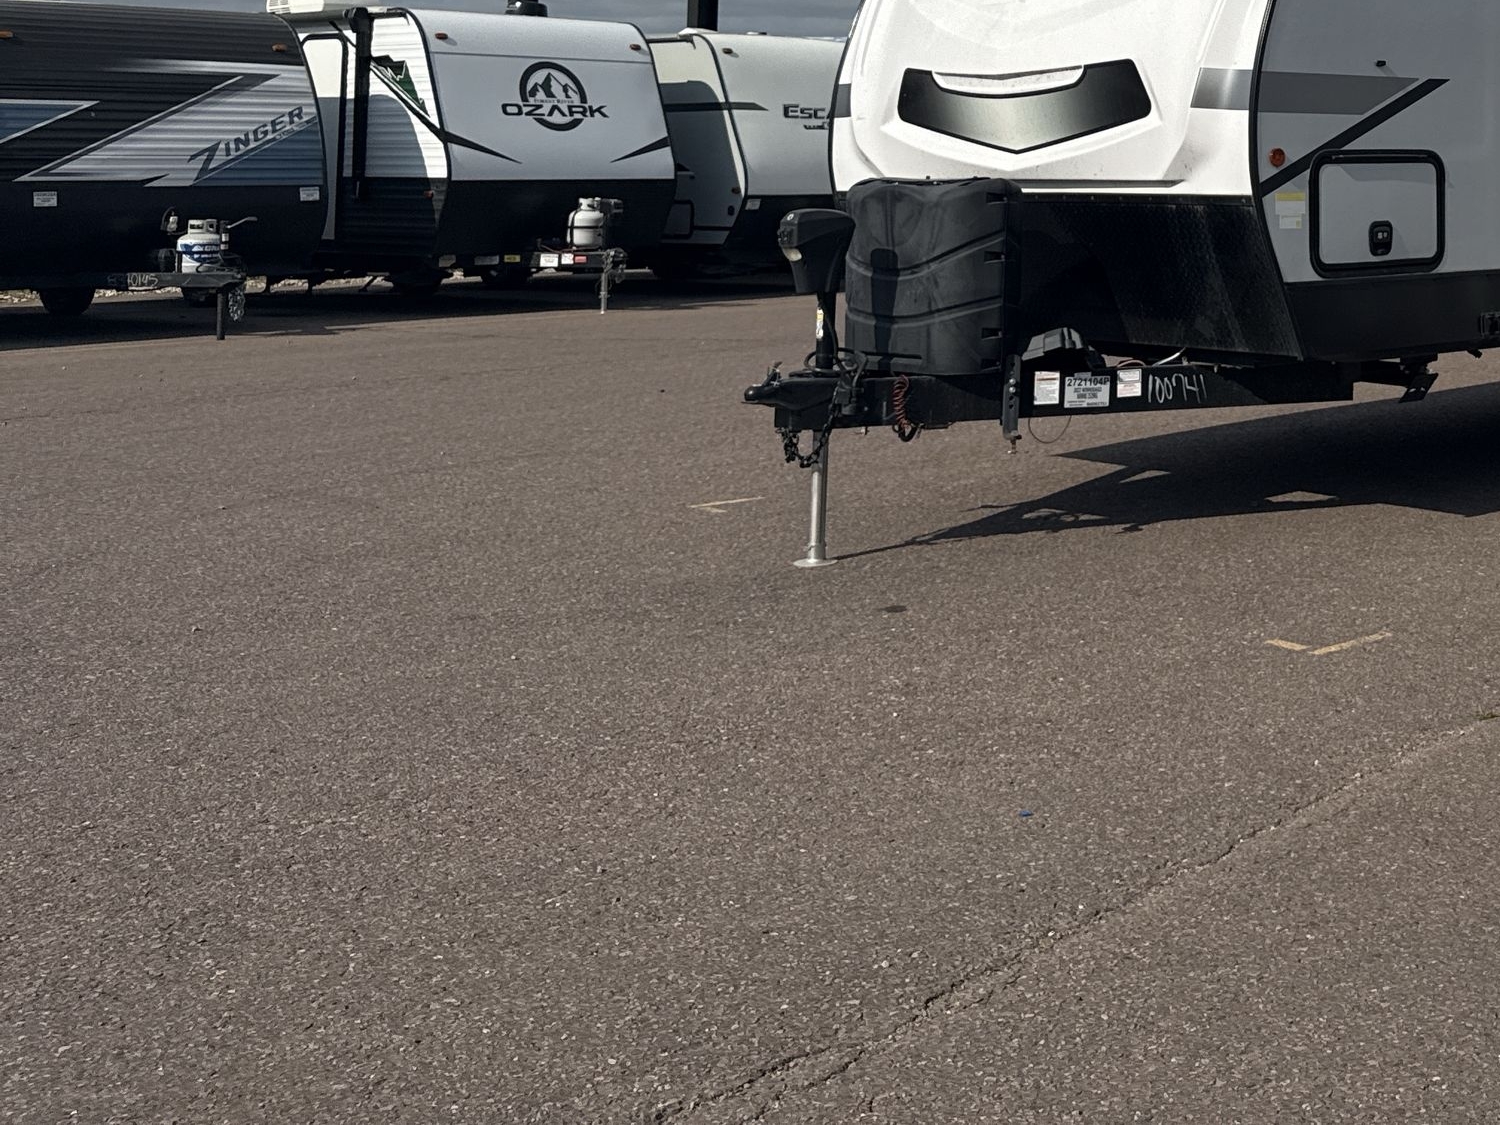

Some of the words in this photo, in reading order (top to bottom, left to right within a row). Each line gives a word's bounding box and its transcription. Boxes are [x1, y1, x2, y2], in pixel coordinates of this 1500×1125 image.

[501, 103, 610, 118] OZARK
[783, 104, 830, 119] ESC
[187, 106, 304, 182] ZINGER
[1148, 373, 1207, 404] 100741
